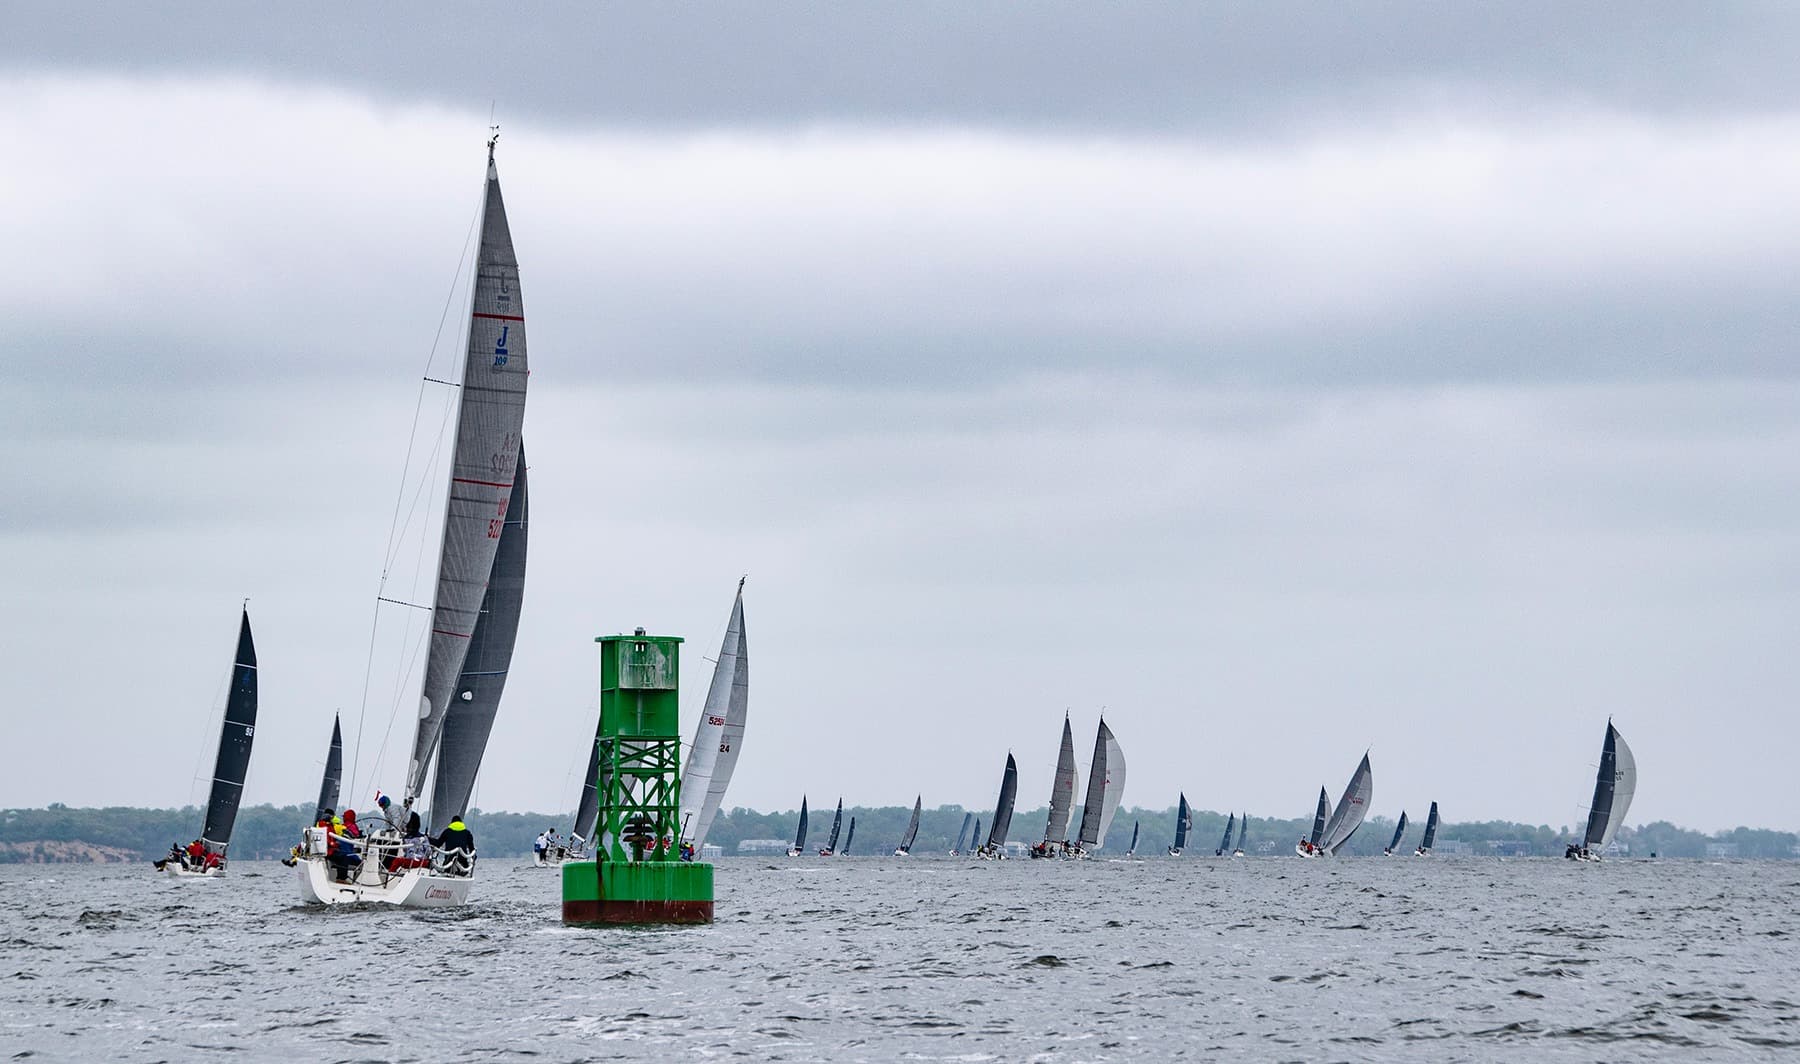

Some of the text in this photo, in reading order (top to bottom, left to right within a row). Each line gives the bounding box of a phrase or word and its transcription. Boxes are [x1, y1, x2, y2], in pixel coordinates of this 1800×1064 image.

[497, 326, 509, 347] J
[494, 356, 508, 366] 109
[719, 744, 730, 753] 24
